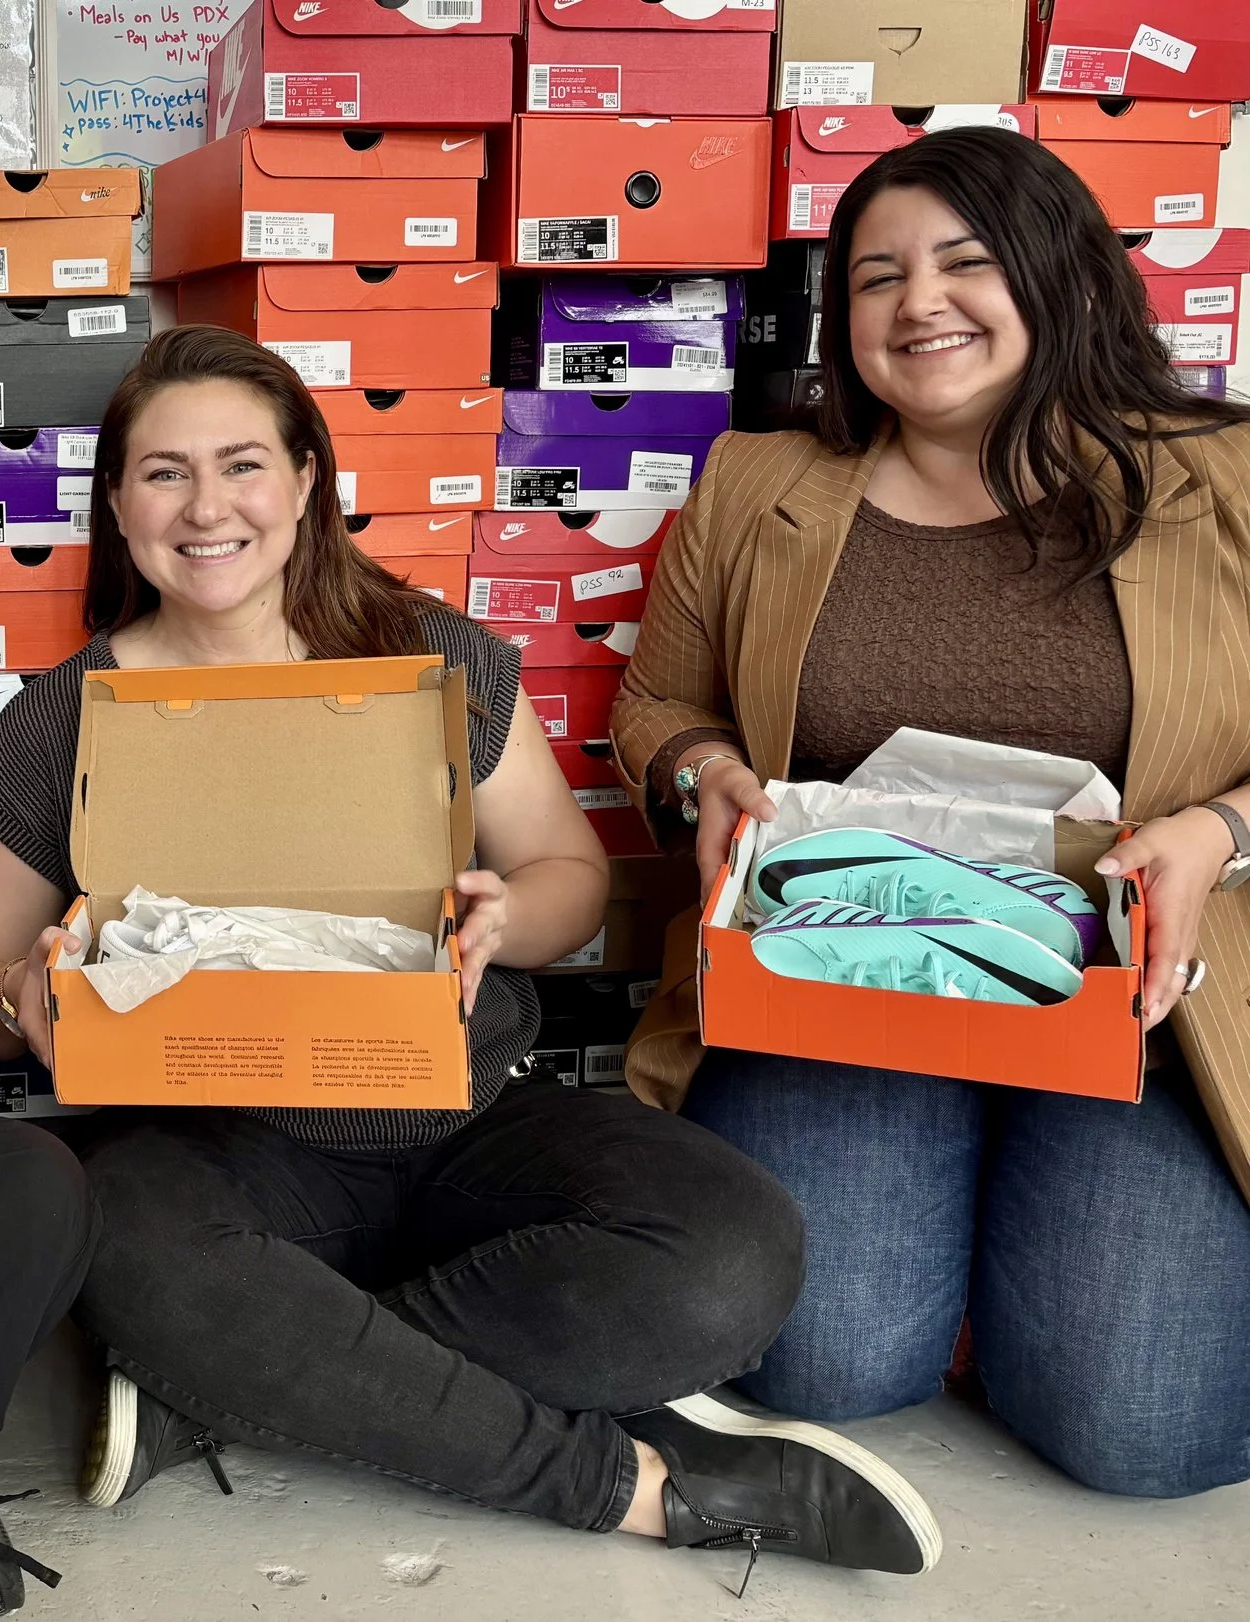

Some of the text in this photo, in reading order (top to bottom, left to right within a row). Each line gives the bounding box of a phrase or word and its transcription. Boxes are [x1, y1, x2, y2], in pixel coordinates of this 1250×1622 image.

[298, 1, 322, 14] NIKE
[80, 4, 230, 25] Meals on Us PDX
[155, 30, 188, 43] what
[197, 33, 220, 50] you
[1161, 43, 1181, 60] 163
[1063, 70, 1073, 78] 9.5
[287, 88, 297, 96] 10
[803, 87, 812, 95] 13
[68, 88, 126, 114] WIFI:
[78, 116, 118, 136] pass:
[824, 117, 846, 129] NIKE
[996, 117, 1013, 127] 305
[699, 136, 738, 155] NIKE
[90, 186, 111, 199] nike
[540, 242, 556, 250] 11.5
[565, 356, 574, 364] 10
[504, 522, 526, 535] NIKE
[608, 569, 624, 582] 92
[510, 634, 530, 646] NIKE
[251, 1062, 283, 1070] responsible
